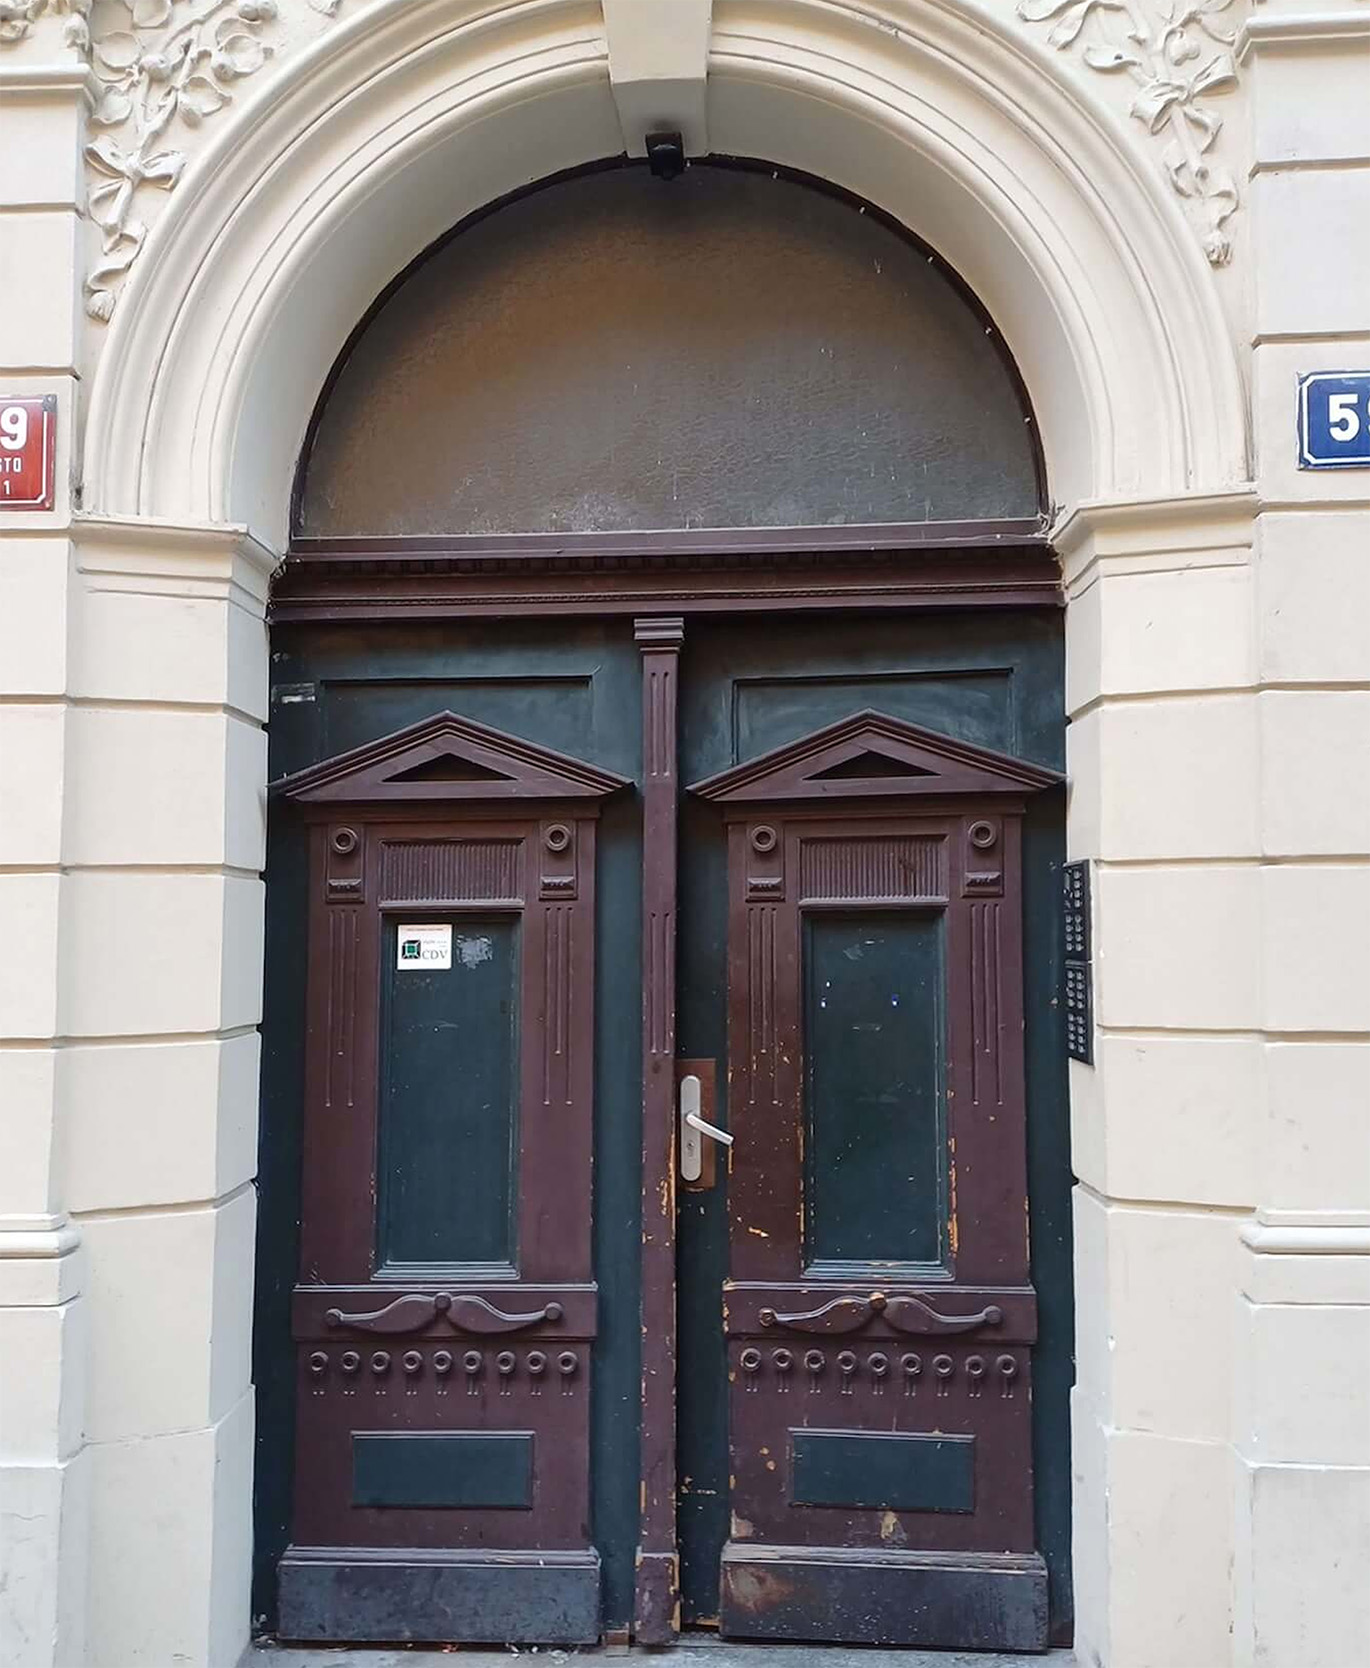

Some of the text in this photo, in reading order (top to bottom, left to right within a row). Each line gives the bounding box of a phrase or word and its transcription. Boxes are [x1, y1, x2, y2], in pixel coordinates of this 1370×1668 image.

[1328, 393, 1370, 442] 5
[0, 406, 28, 451] 9
[0, 457, 22, 473] TO
[3, 479, 11, 495] 1
[421, 949, 448, 960] CDV
